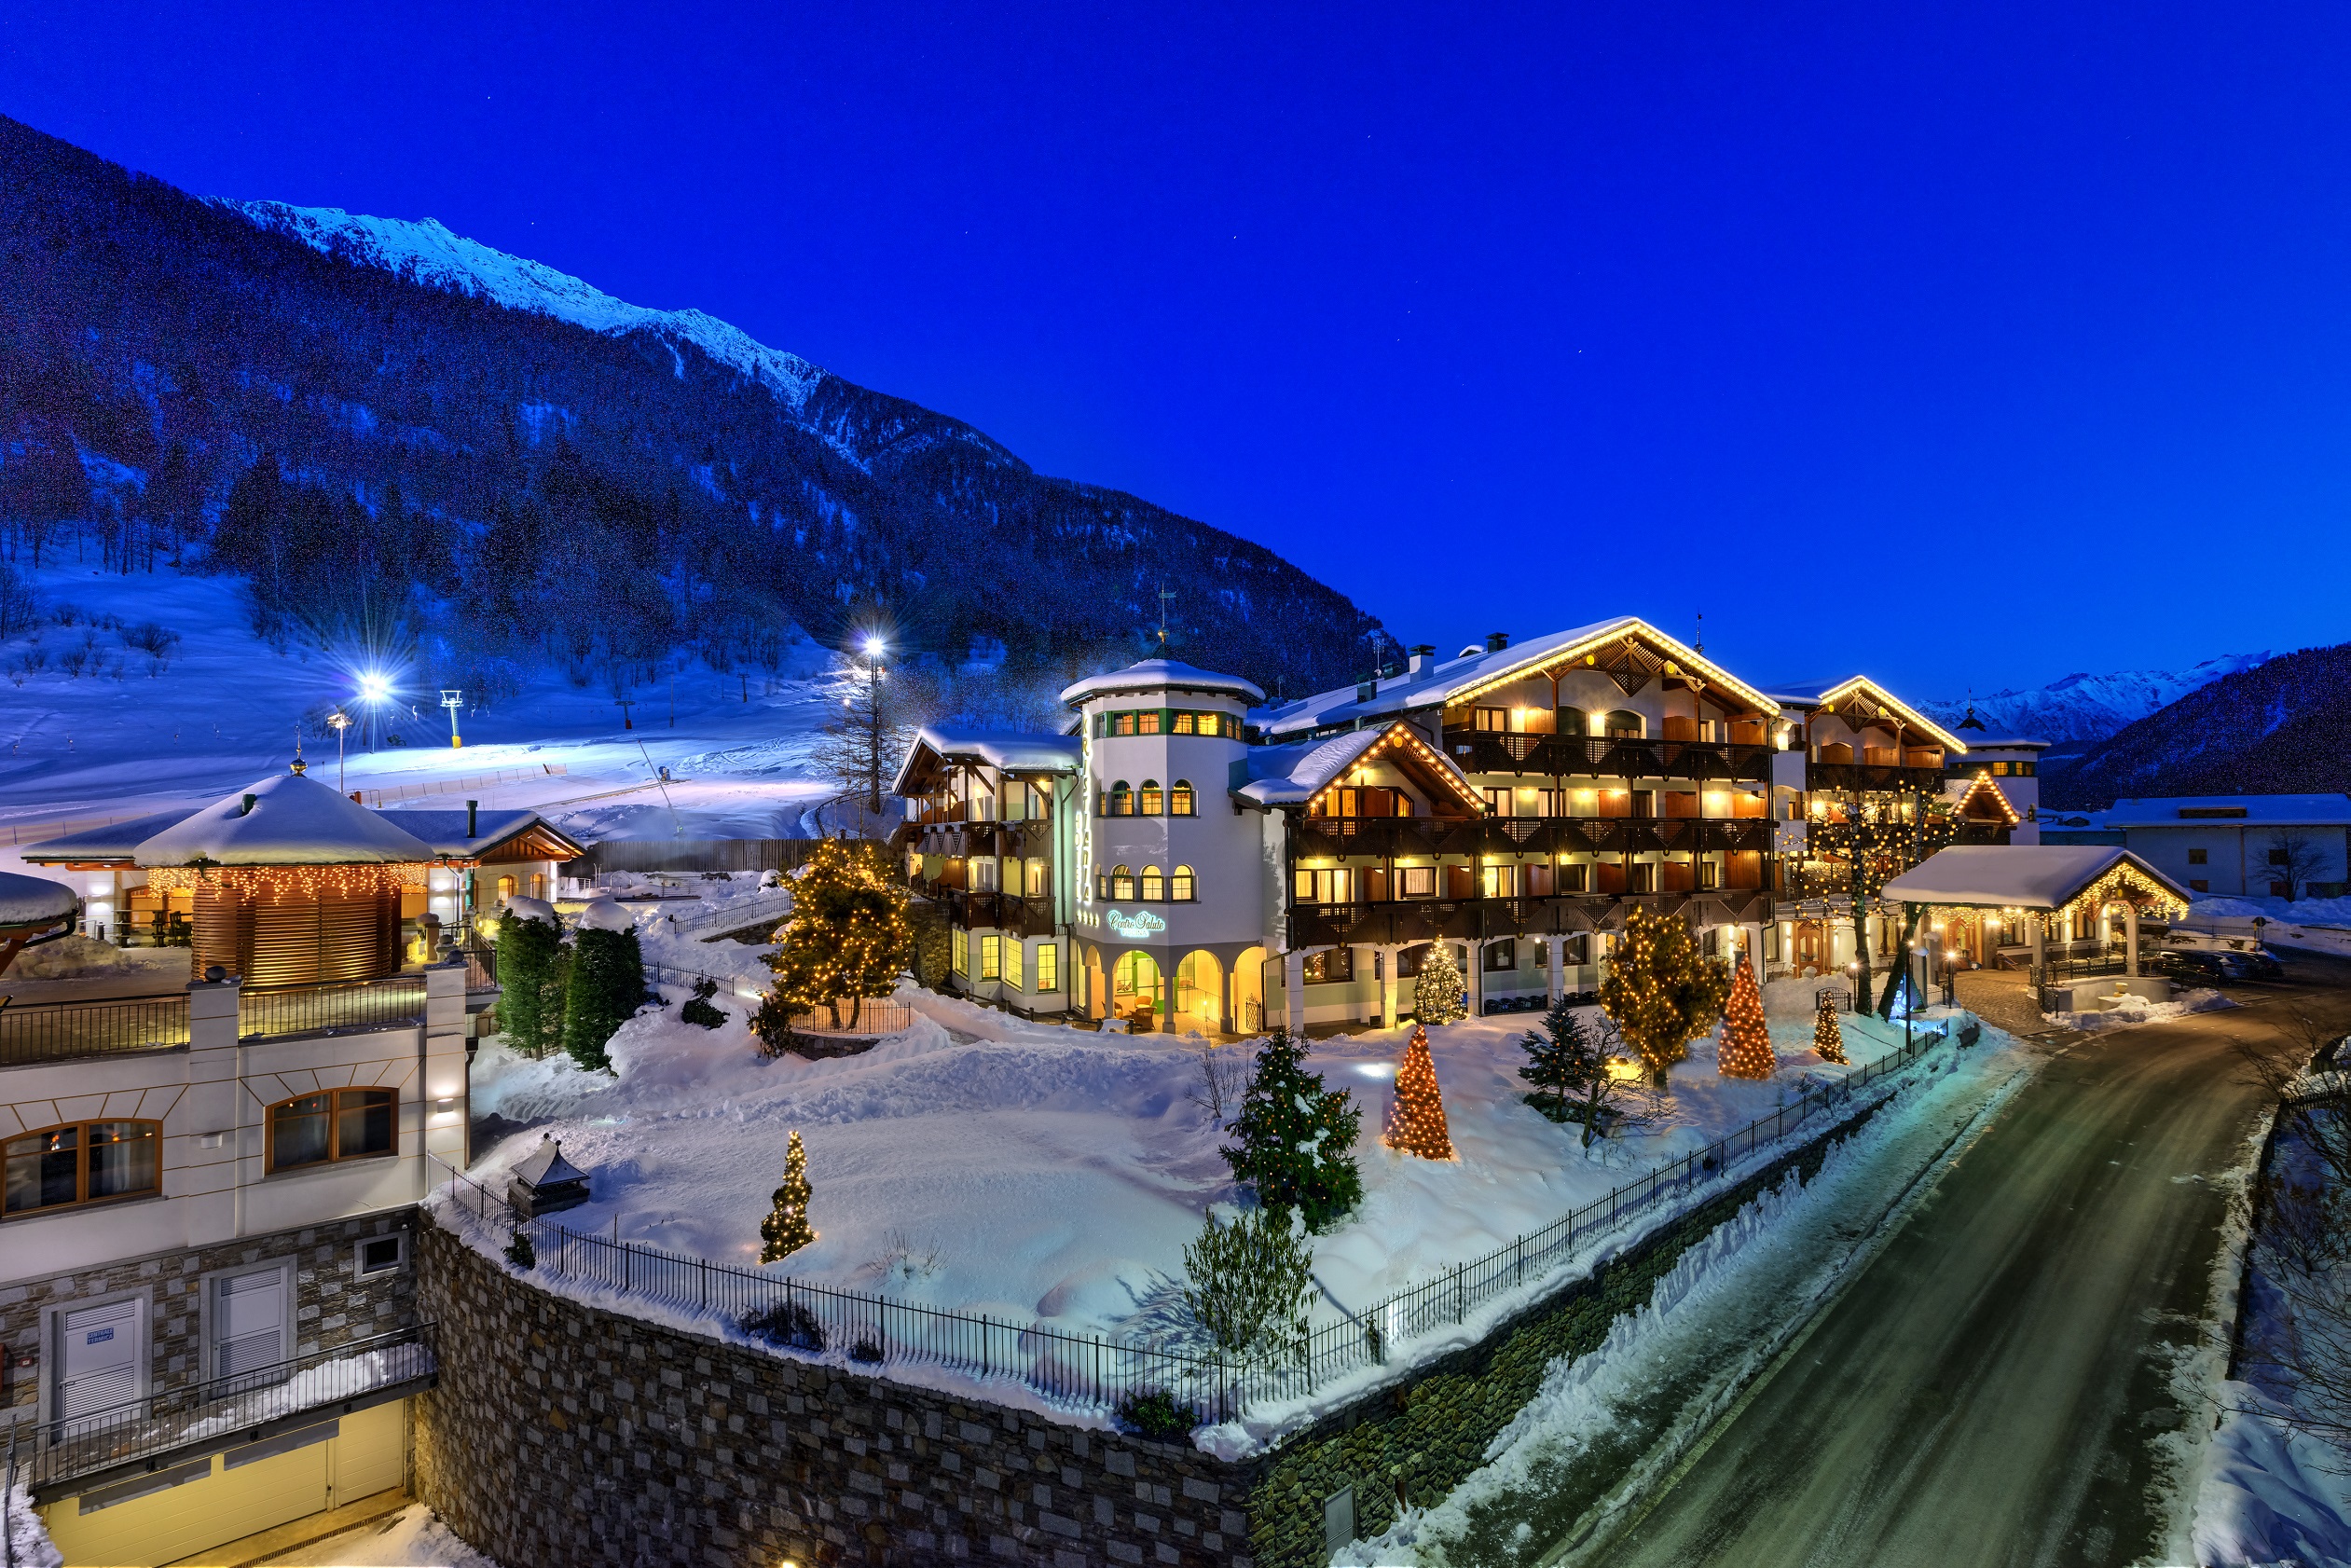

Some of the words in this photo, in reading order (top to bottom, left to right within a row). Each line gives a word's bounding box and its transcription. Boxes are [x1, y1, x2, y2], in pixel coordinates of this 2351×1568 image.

[1107, 910, 1134, 931] Centro
[1135, 912, 1164, 930] Salute
[89, 1327, 113, 1338] CENTRALE
[88, 1334, 113, 1344] TERMICA
